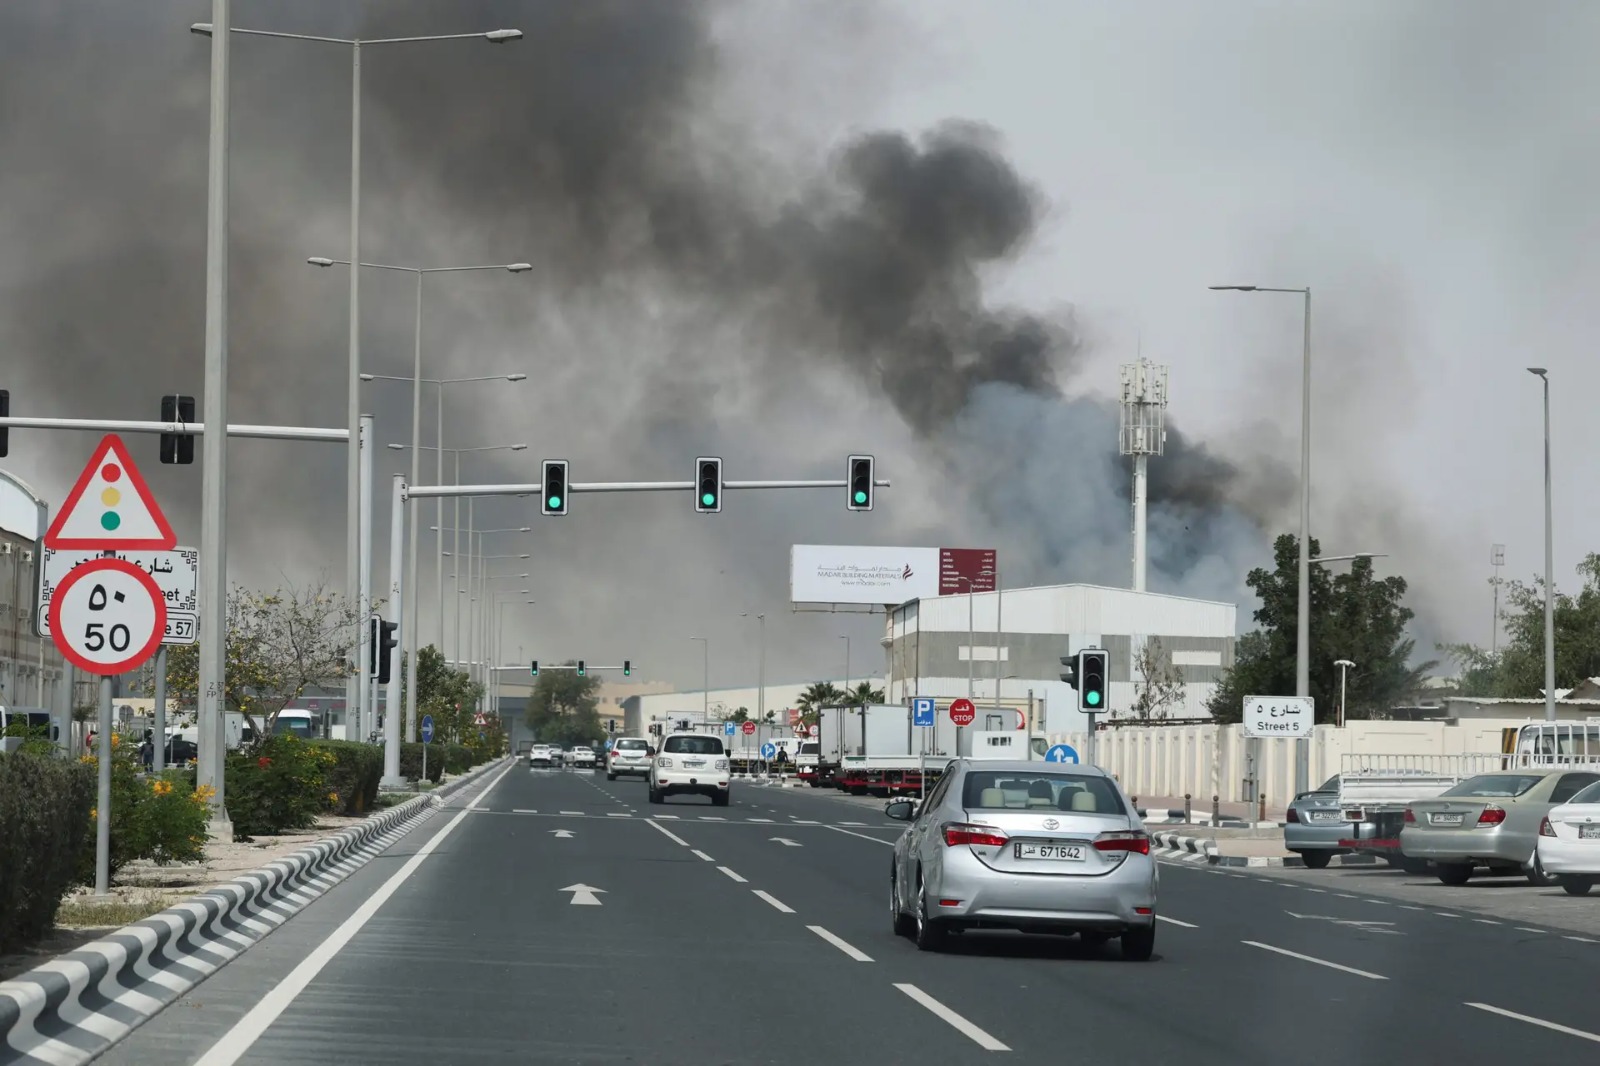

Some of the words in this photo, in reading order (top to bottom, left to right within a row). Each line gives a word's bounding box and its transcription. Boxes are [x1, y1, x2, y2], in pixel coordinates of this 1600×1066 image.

[176, 621, 192, 636] 57
[84, 623, 130, 652] 50
[917, 700, 931, 718] P
[1270, 705, 1301, 717] شارع
[953, 714, 973, 722] STOP
[726, 722, 734, 732] P
[1257, 721, 1290, 731] Street
[1292, 721, 1300, 731] 5
[1040, 846, 1080, 859] 671642
